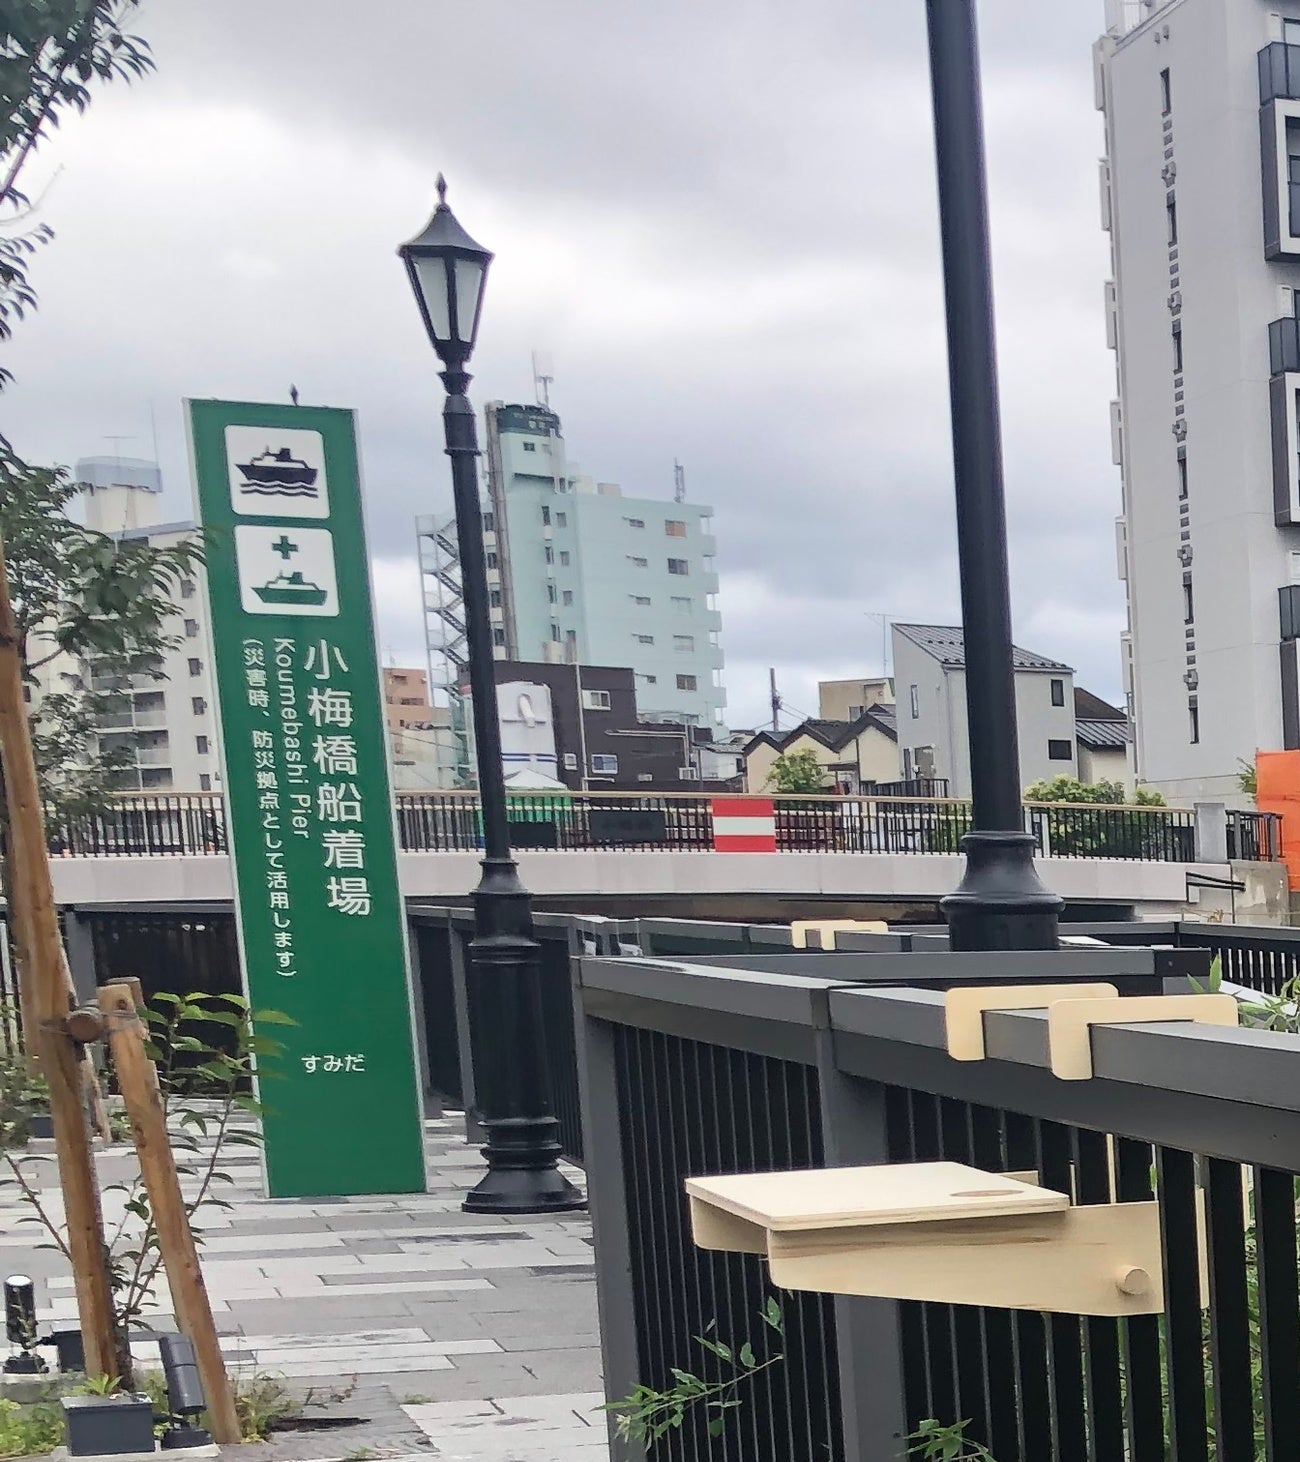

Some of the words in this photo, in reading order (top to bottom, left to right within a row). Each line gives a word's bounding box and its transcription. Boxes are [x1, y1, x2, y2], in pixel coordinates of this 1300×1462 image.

[273, 637, 309, 784] Koumebashi
[289, 794, 312, 839] Pier
[303, 639, 372, 916] 小梅橋船着場
[301, 1053, 365, 1074] すみだ
